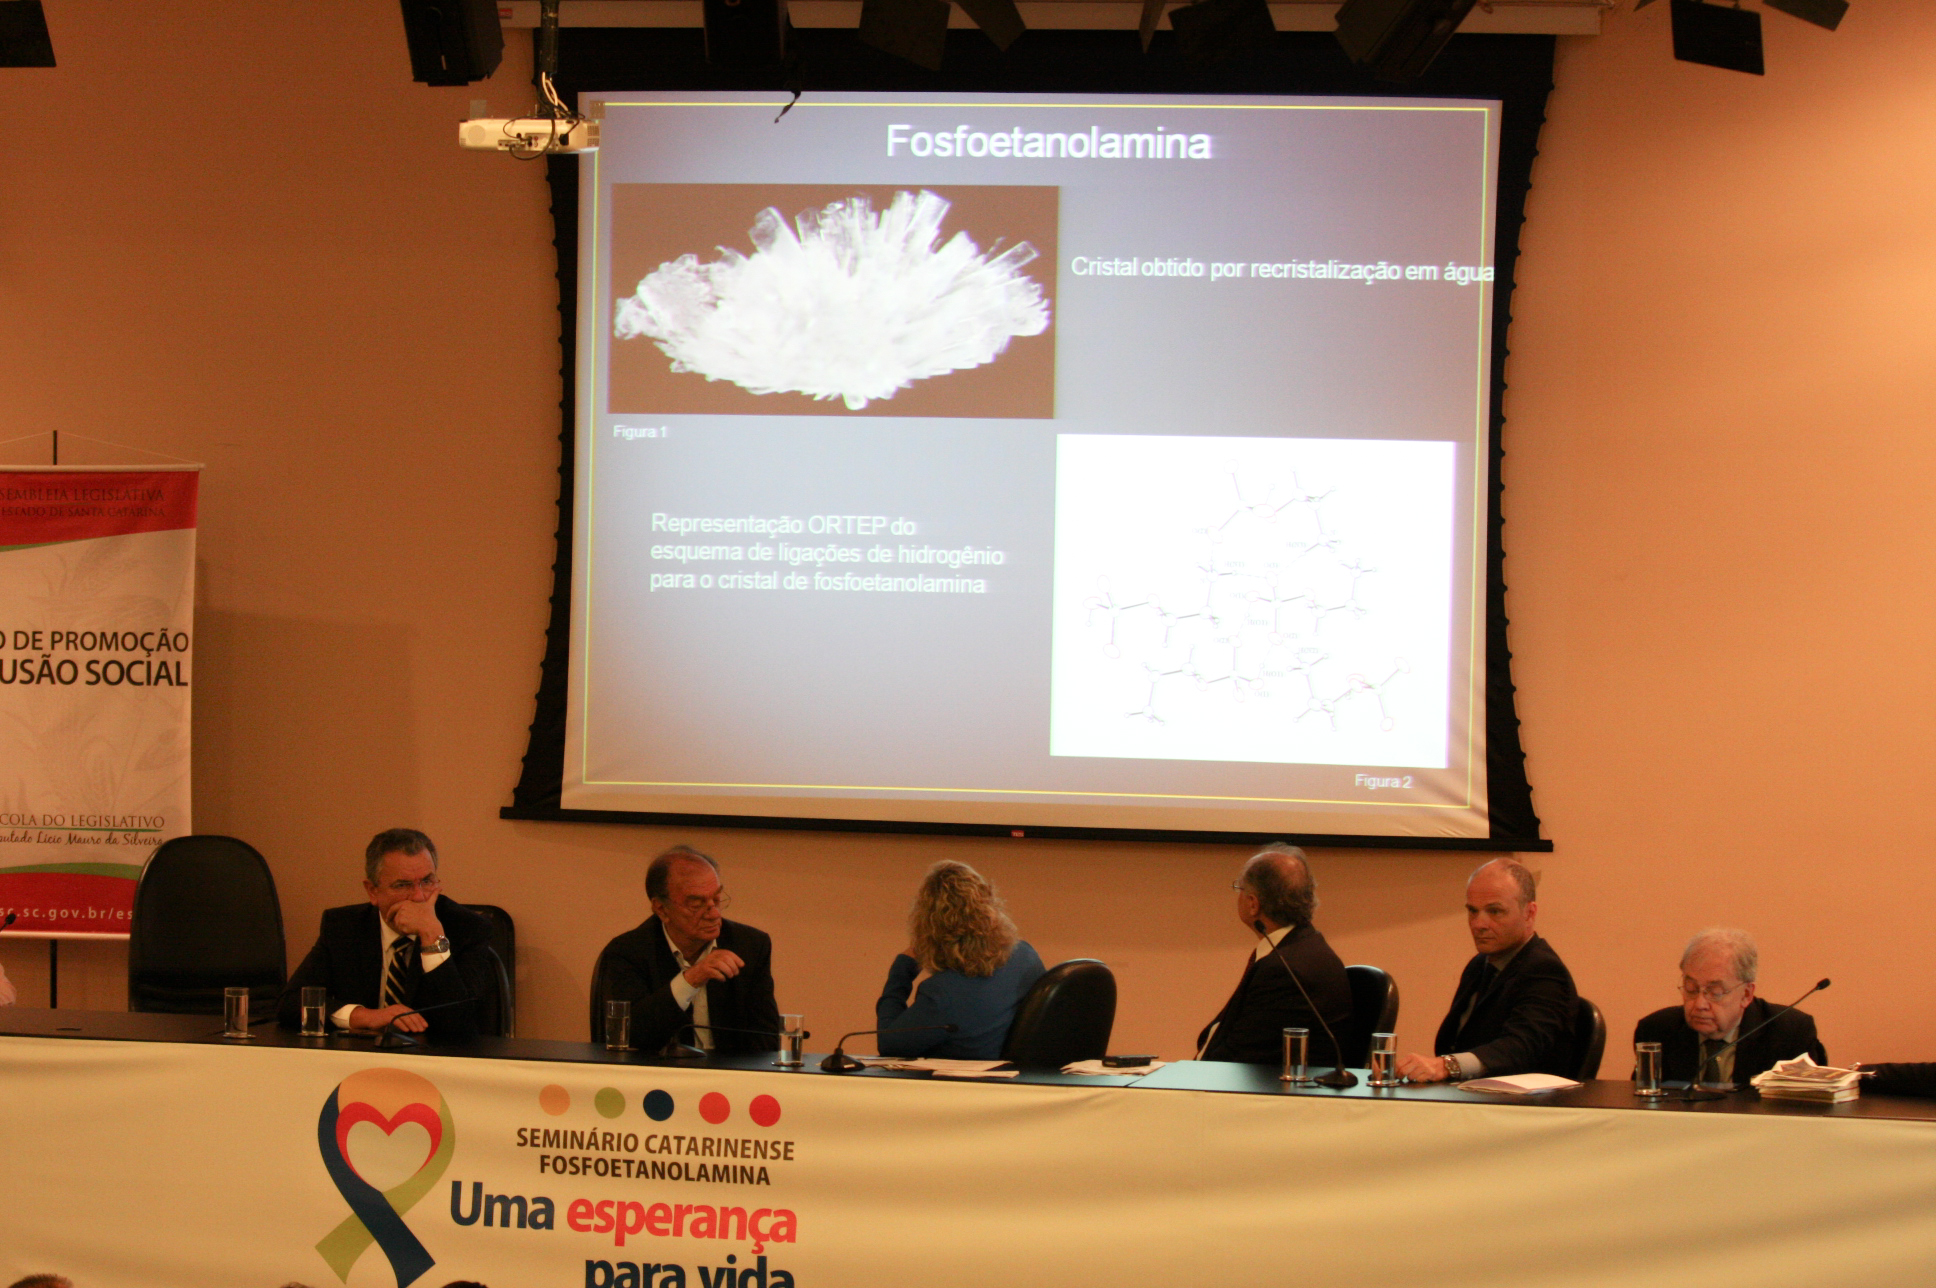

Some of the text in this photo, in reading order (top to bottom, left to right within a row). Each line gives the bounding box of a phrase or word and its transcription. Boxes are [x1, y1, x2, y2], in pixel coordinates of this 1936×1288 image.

[887, 124, 1212, 159] Fosfoetanolamina
[1071, 256, 1495, 286] Cristal obtido por recristalização em água
[613, 424, 667, 440] Figura 1
[74, 488, 165, 501] LEGISLATIVA
[2, 506, 165, 518] ESTADO DE SANTA CATARINA
[651, 512, 916, 538] Representação ORTEP do
[650, 542, 1004, 568] esquema de ligações de hidrogênio
[650, 570, 986, 593] para o cristal de fosfoetanolamina
[13, 631, 43, 650] DE
[51, 628, 189, 657] PROMOÇÃO
[0, 653, 188, 686] USÃO SOCIAL
[1355, 773, 1413, 790] Figura 2
[0, 813, 165, 828] COLA DO LEGISLATIVO
[64, 833, 101, 845] Mauro
[105, 832, 119, 845] da
[122, 831, 163, 846] Silveira
[516, 1127, 795, 1161] SEMINÁRIO CATARINENSE
[539, 1154, 771, 1186] FOSFOETANOLAMINA
[450, 1180, 798, 1255] Uma esperança
[584, 1253, 796, 1288] para vida
